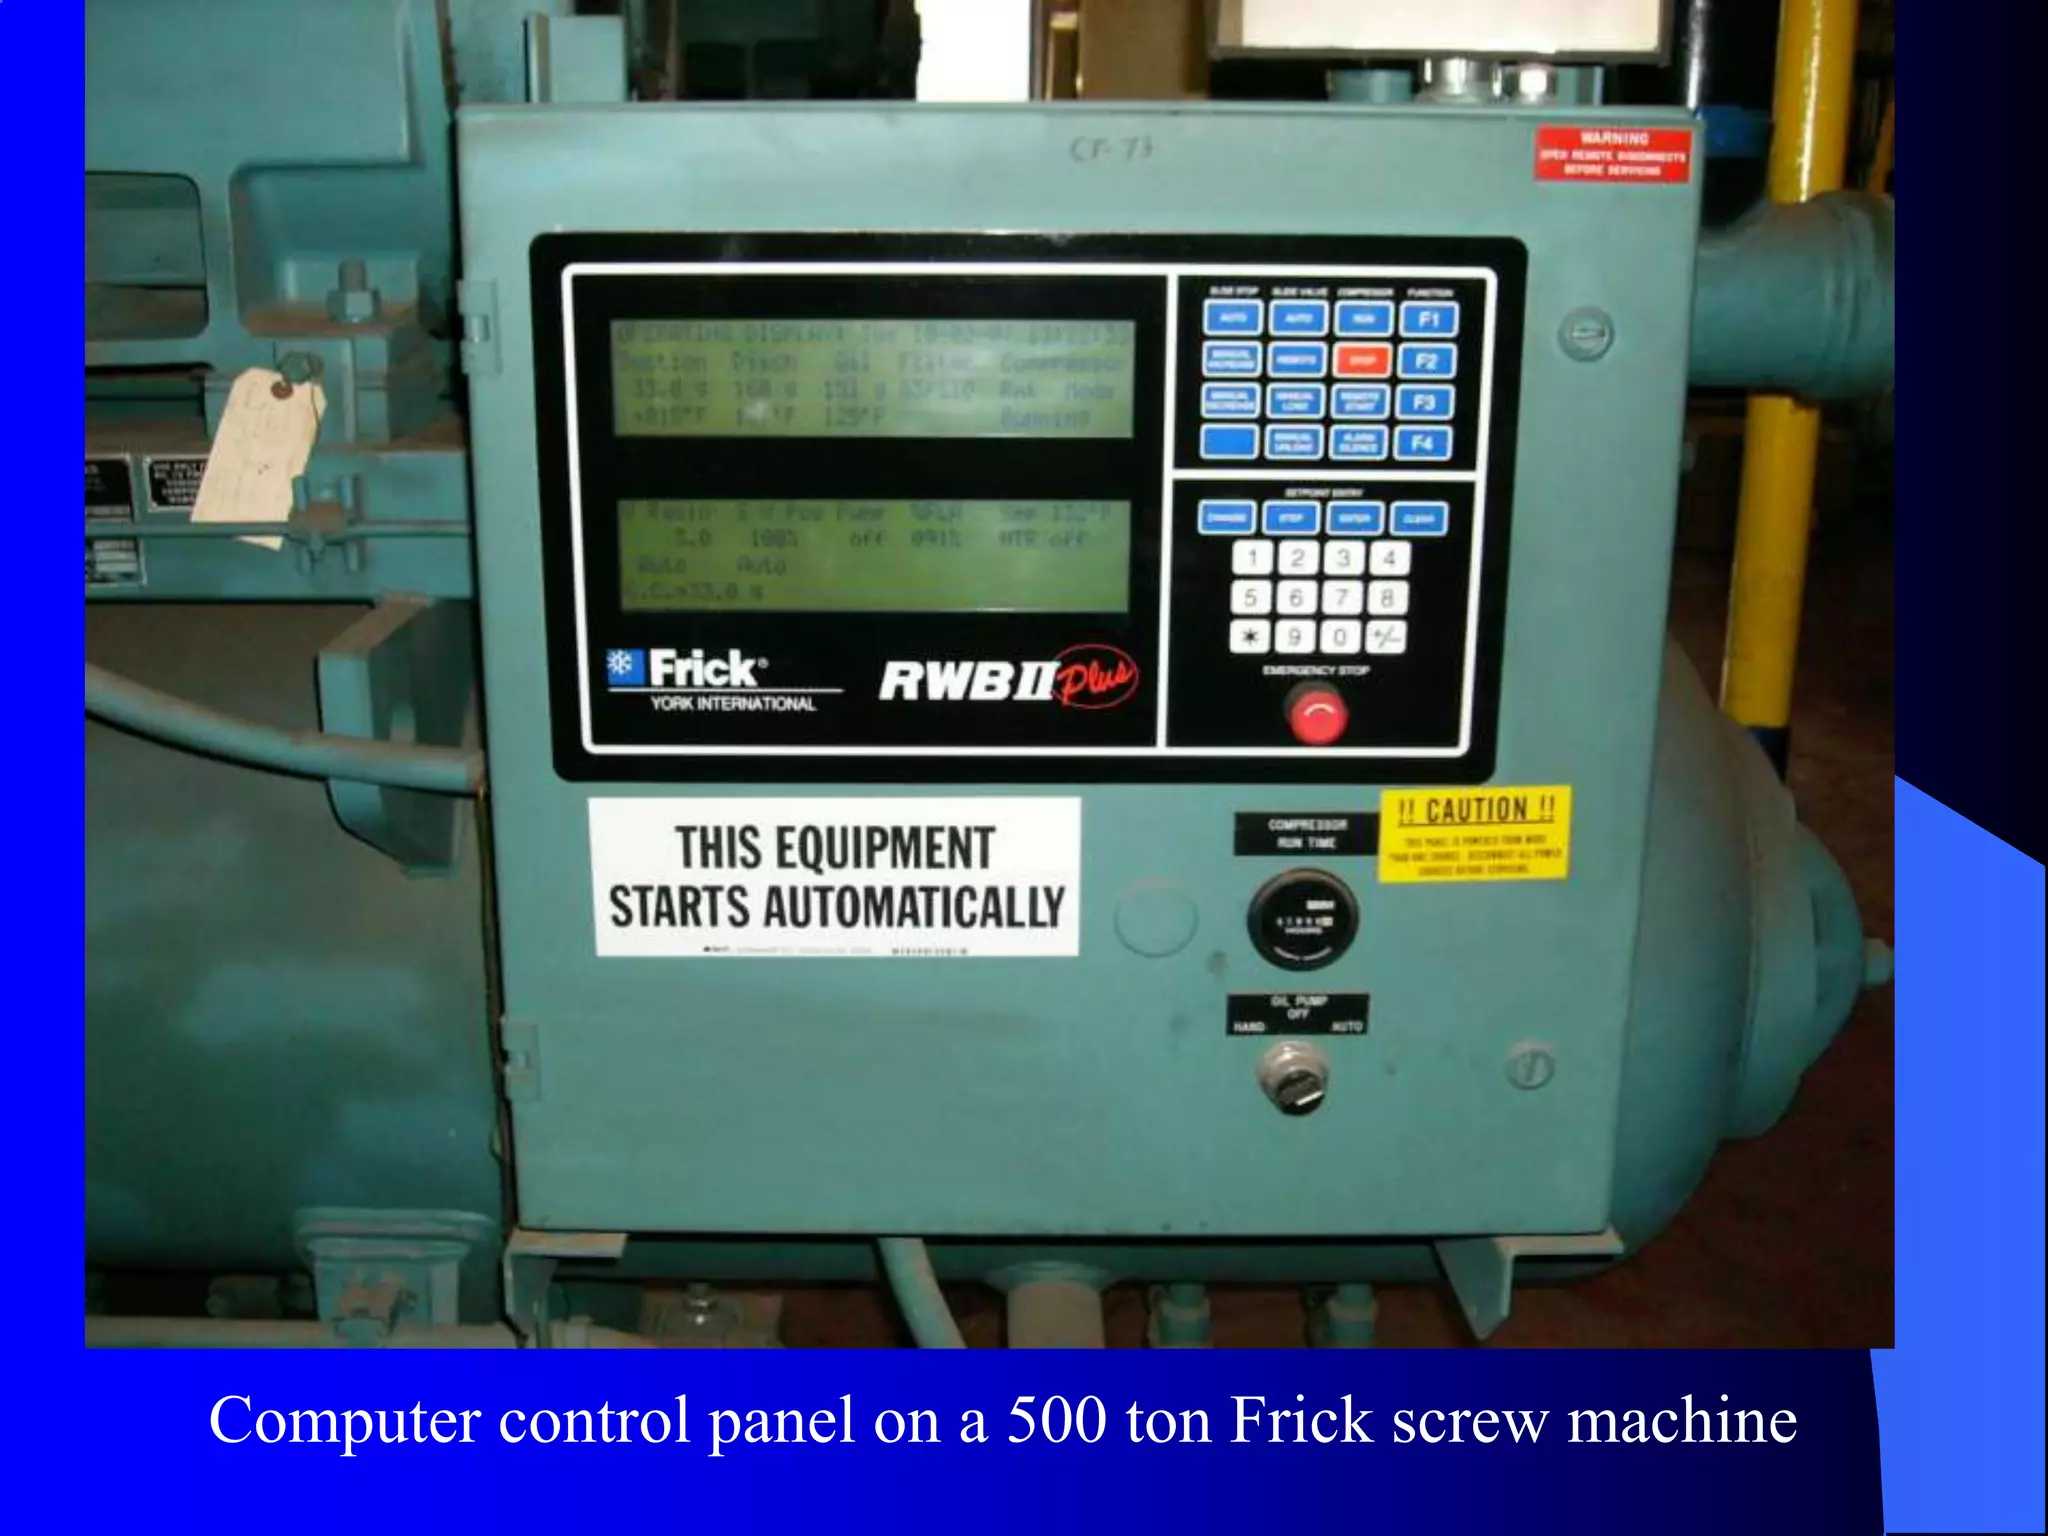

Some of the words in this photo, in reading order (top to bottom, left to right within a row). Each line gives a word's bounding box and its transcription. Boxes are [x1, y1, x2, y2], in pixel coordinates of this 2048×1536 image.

[1580, 131, 1650, 145] WARNING
[1419, 311, 1440, 327] F1
[1415, 353, 1438, 370] F2
[1413, 394, 1436, 411] F3
[1411, 434, 1435, 452] F4
[1249, 549, 1258, 566] 1
[1291, 548, 1306, 567] 2
[1337, 549, 1351, 567] 3
[1383, 549, 1397, 566] 4
[1244, 588, 1258, 607] 5
[1289, 588, 1304, 608] 6
[1336, 588, 1350, 606] 7
[1381, 588, 1395, 608] 8
[1289, 627, 1302, 647] 9
[1334, 628, 1347, 647] 0
[1262, 664, 1335, 676] EMERGENCY
[1338, 664, 1371, 676] STOP
[1058, 661, 1134, 706] Plus
[652, 695, 694, 712] YORK
[698, 696, 817, 713] INTERNATIONAL
[1427, 796, 1528, 823] CAUTION
[1268, 818, 1348, 832] COMPRESSOR
[675, 825, 762, 869] THIS
[777, 825, 996, 875] EQUIPMENT
[1277, 836, 1304, 849] RUN
[1308, 836, 1337, 849] TIME
[610, 885, 750, 928] STARTS
[764, 885, 1065, 929] AUTOMATICALLY
[1271, 995, 1290, 1007] OIL
[1296, 995, 1329, 1006] PUMP
[1287, 1008, 1310, 1020] OFF
[1233, 1021, 1266, 1032] HAND
[1331, 1021, 1364, 1032] AUTO
